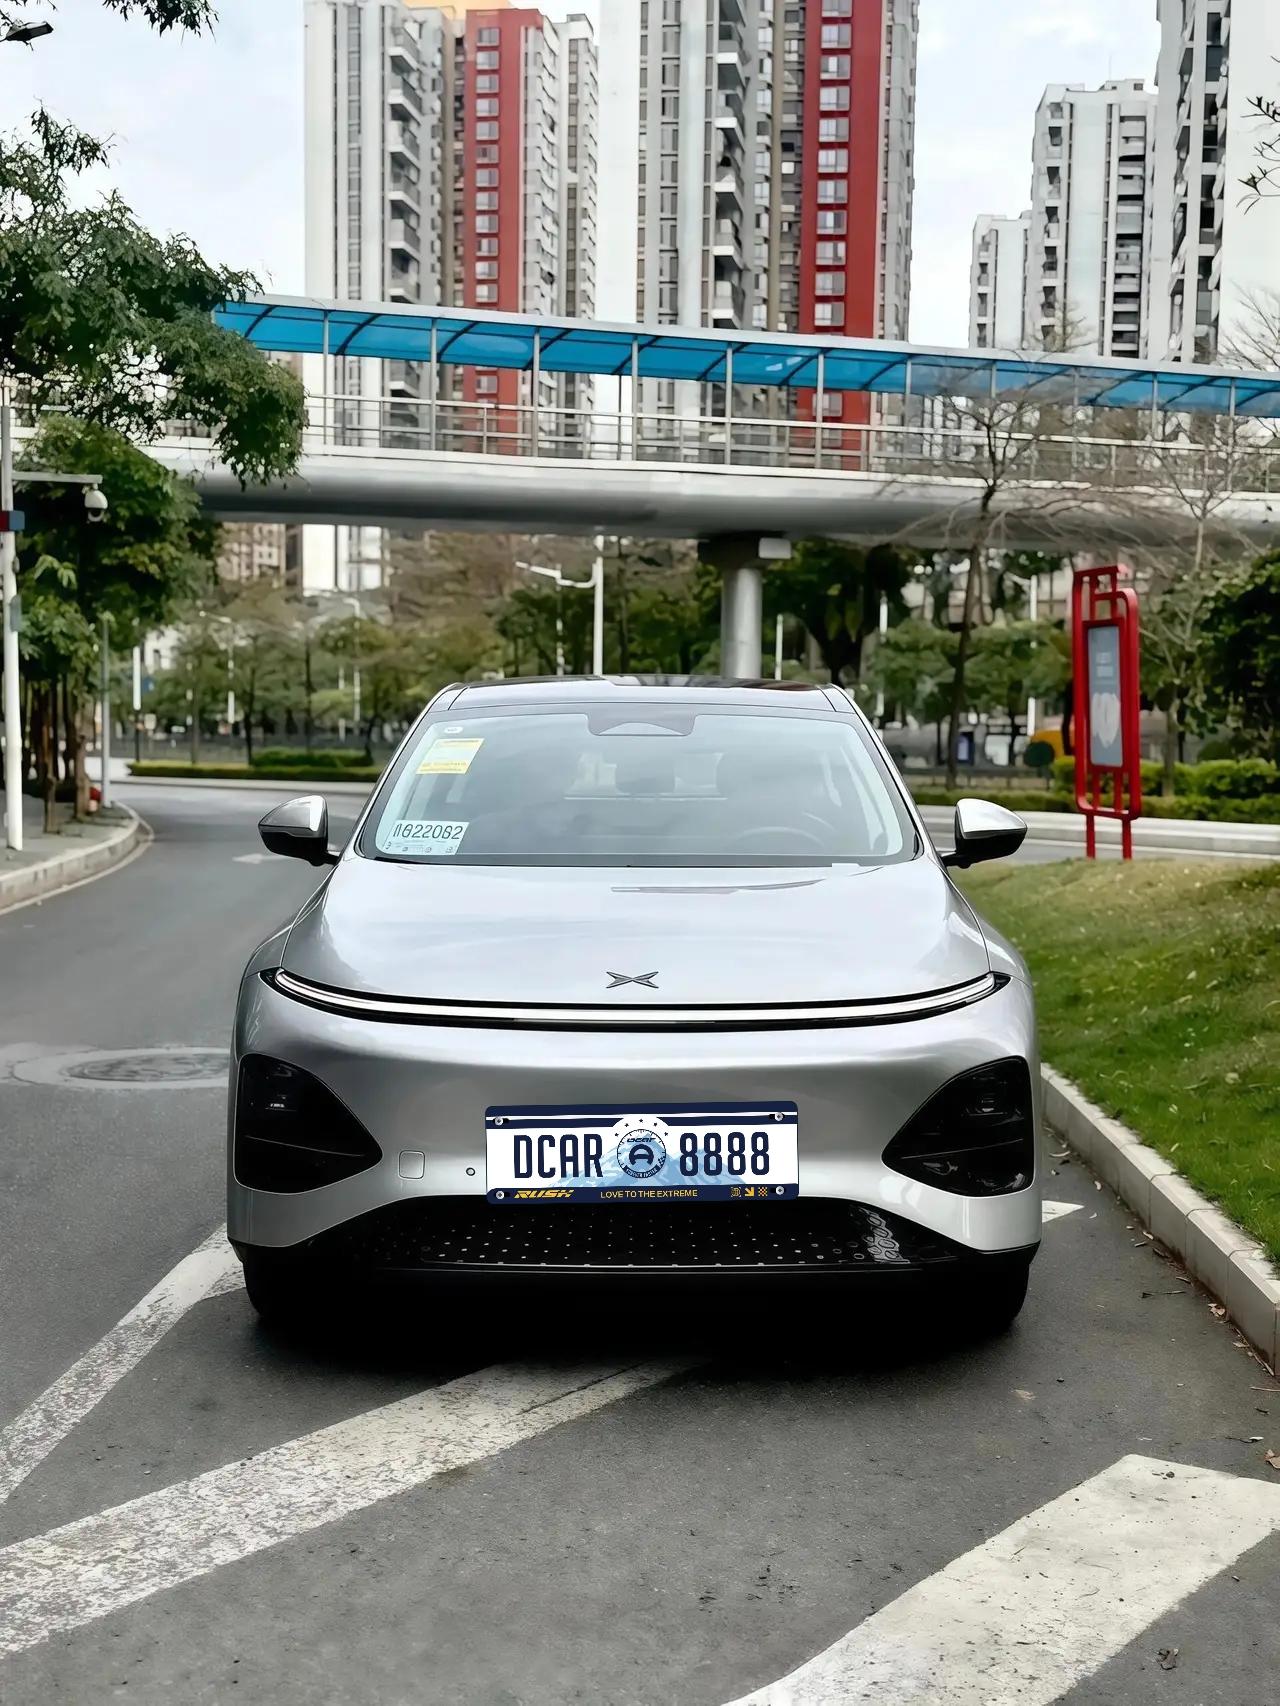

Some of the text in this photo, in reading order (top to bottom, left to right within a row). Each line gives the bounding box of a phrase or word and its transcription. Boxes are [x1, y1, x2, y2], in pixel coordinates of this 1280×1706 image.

[513, 1131, 770, 1179] DCAR 8888
[600, 1189, 698, 1199] LOVE TO THE EXTREME
